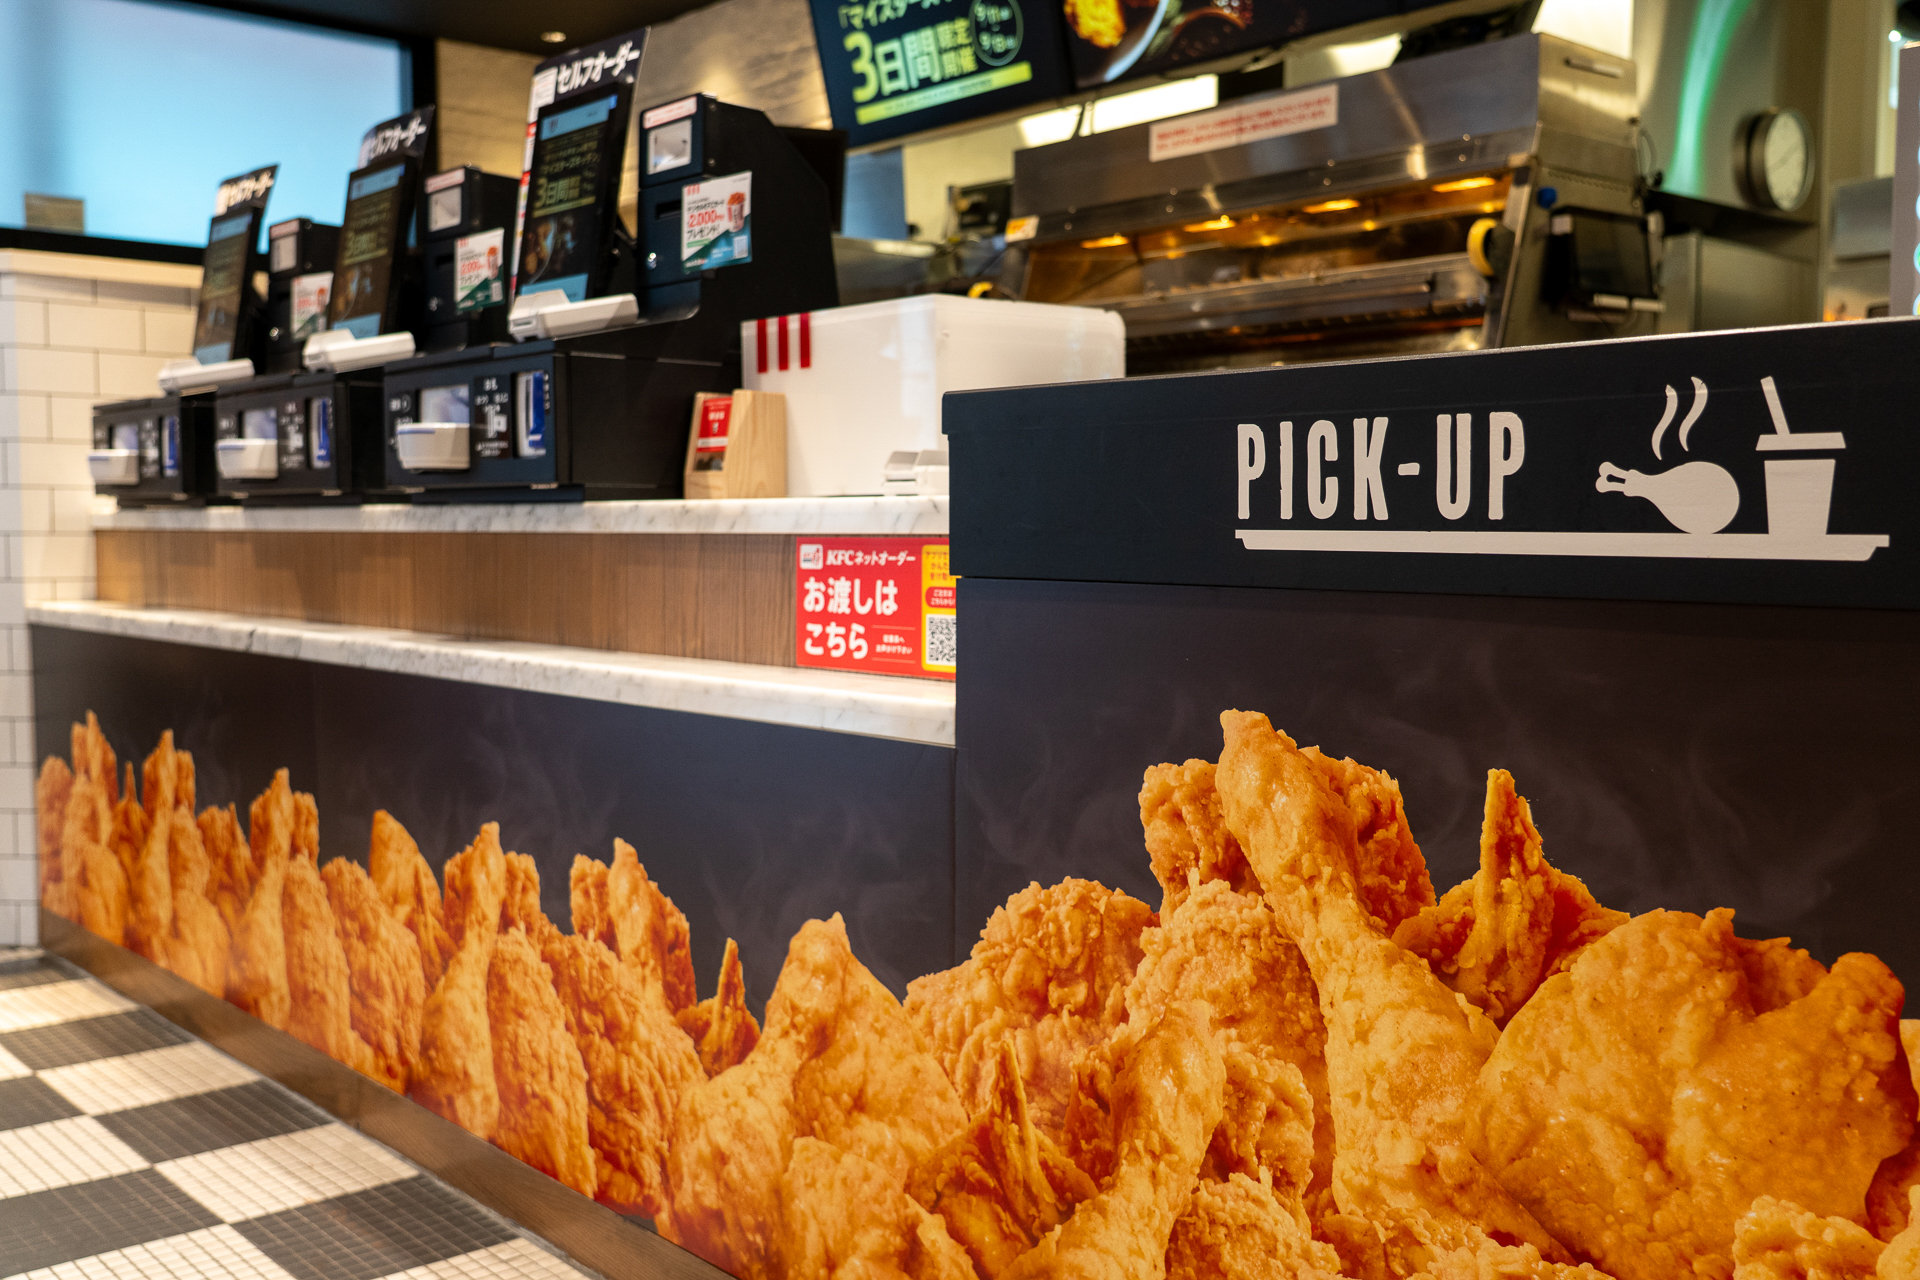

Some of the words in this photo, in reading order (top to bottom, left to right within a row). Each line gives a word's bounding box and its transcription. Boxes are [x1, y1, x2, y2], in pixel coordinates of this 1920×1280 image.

[557, 40, 641, 94] セルフオーダー
[843, 26, 943, 103] 3日間
[1238, 411, 1526, 521] PICK-UP
[803, 576, 898, 616] お渡しは
[804, 621, 869, 660] こちら
